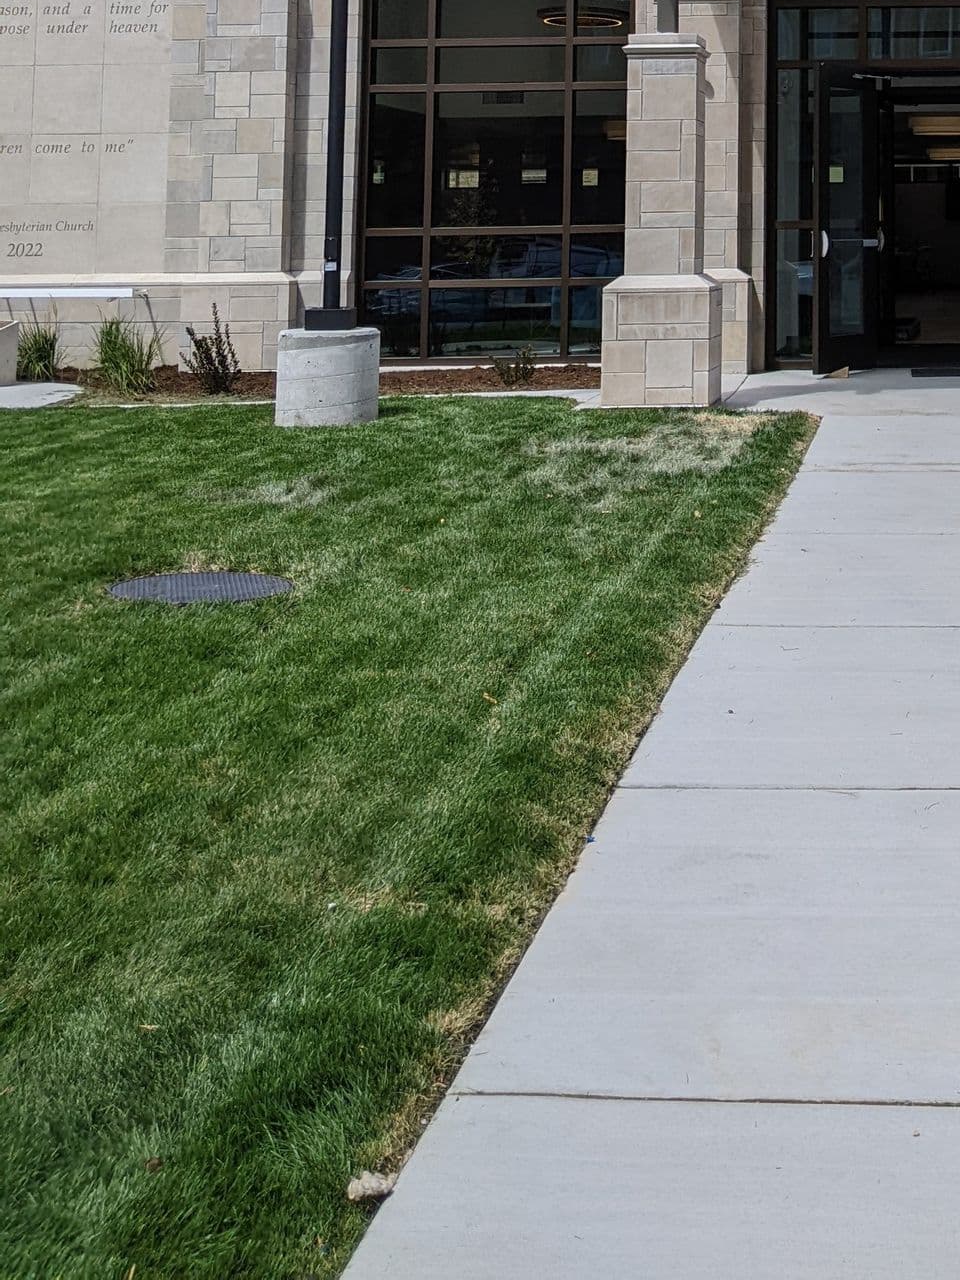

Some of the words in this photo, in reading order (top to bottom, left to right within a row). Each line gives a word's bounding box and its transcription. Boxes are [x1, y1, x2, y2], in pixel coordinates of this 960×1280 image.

[43, 2, 70, 15] and
[83, 5, 91, 15] a
[110, 1, 141, 15] time
[147, 0, 169, 18] for
[47, 21, 88, 34] under
[109, 20, 158, 33] heaven
[35, 142, 72, 154] come
[81, 141, 95, 153] to
[55, 220, 94, 232] Church
[7, 243, 43, 257] 2022
